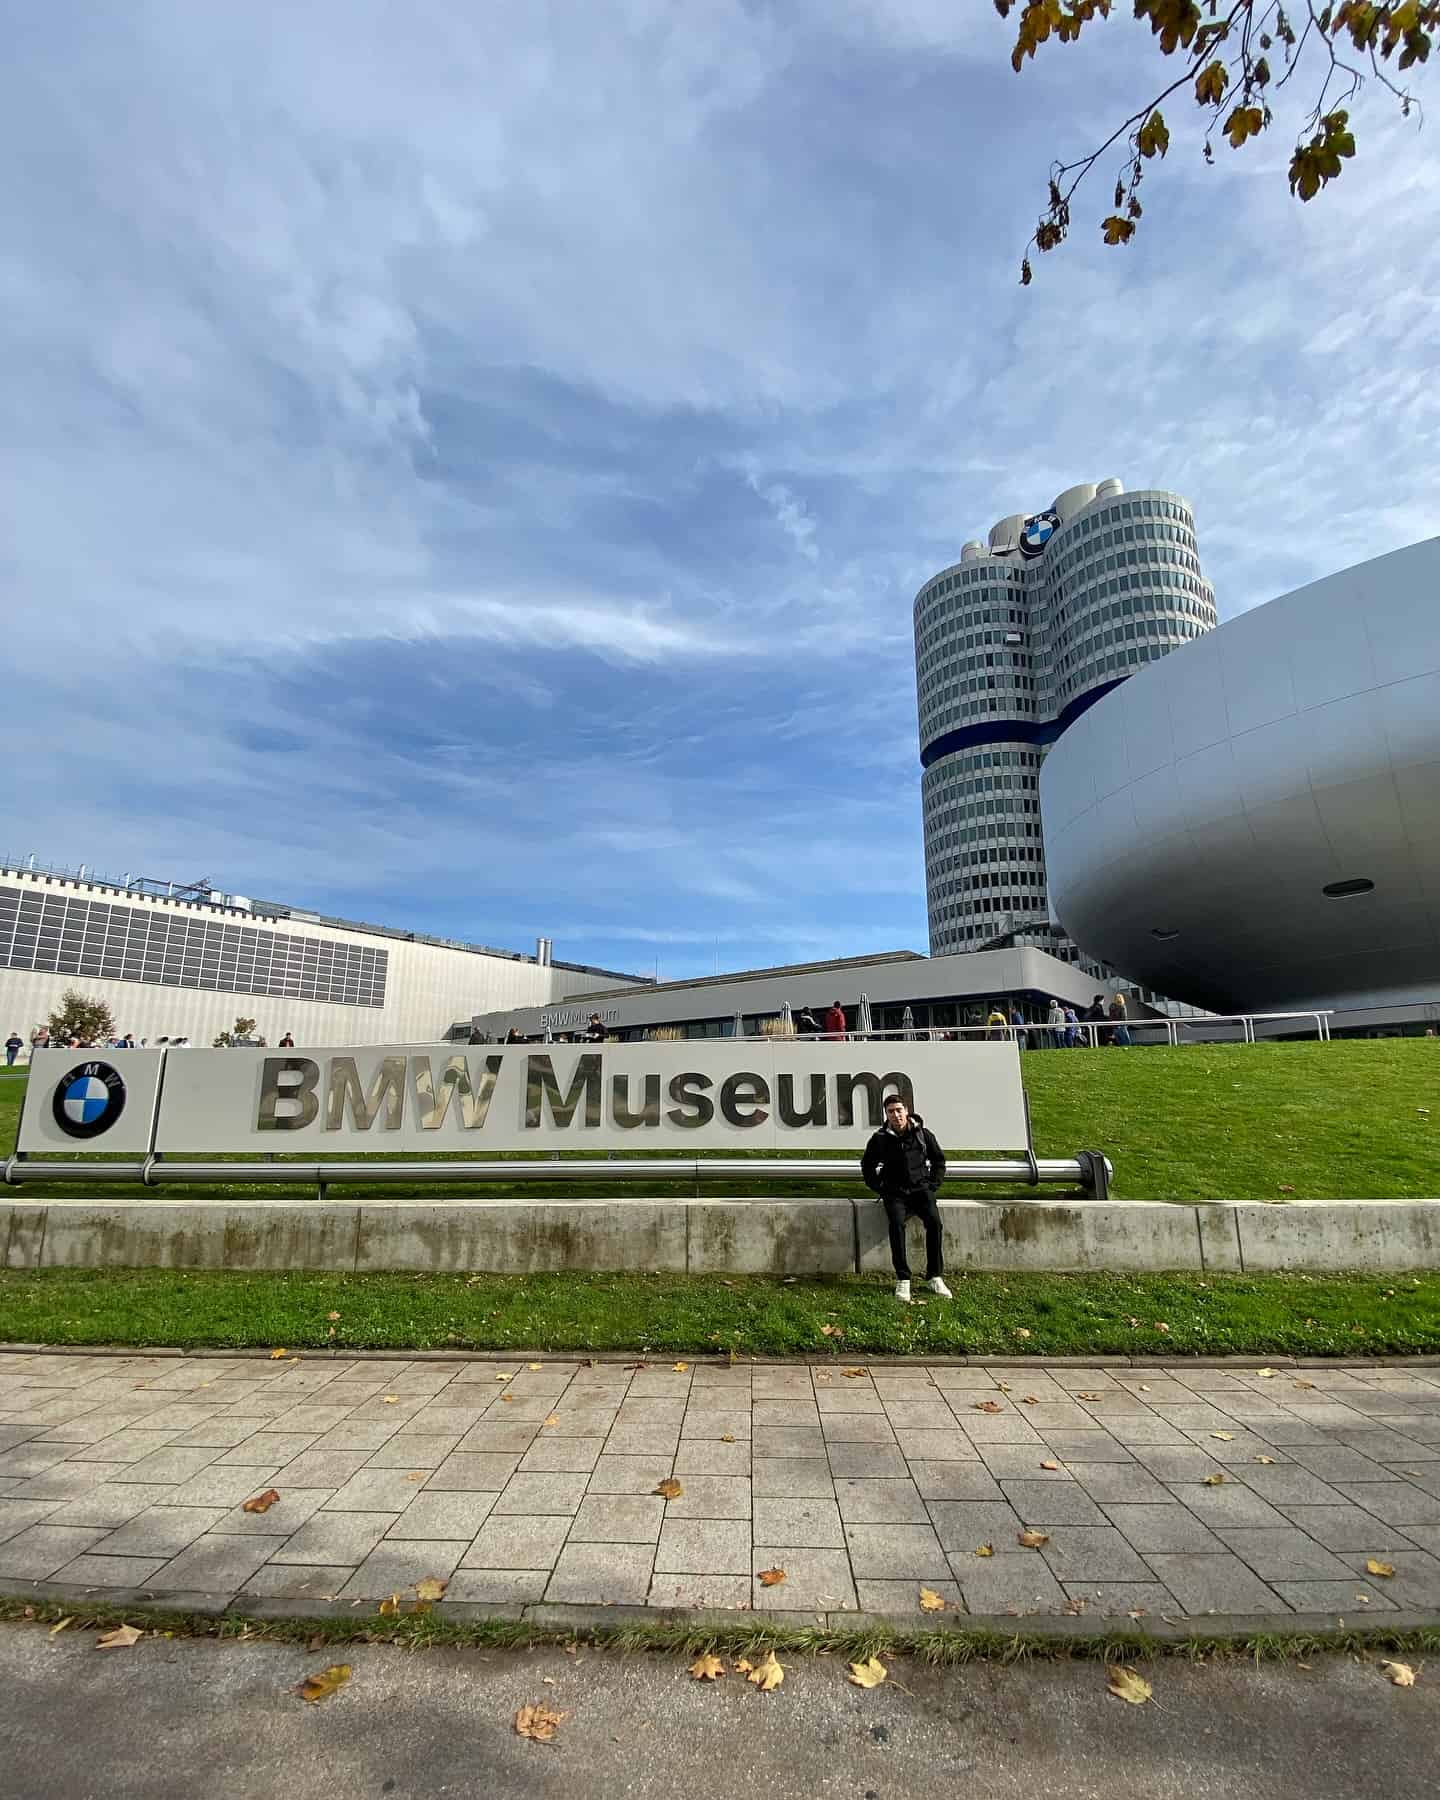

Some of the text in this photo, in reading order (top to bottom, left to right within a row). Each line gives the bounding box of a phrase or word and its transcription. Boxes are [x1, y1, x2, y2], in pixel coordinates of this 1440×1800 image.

[540, 1011, 569, 1027] BMW
[62, 1063, 121, 1088] BMW
[257, 1054, 914, 1130] BMW Museum
